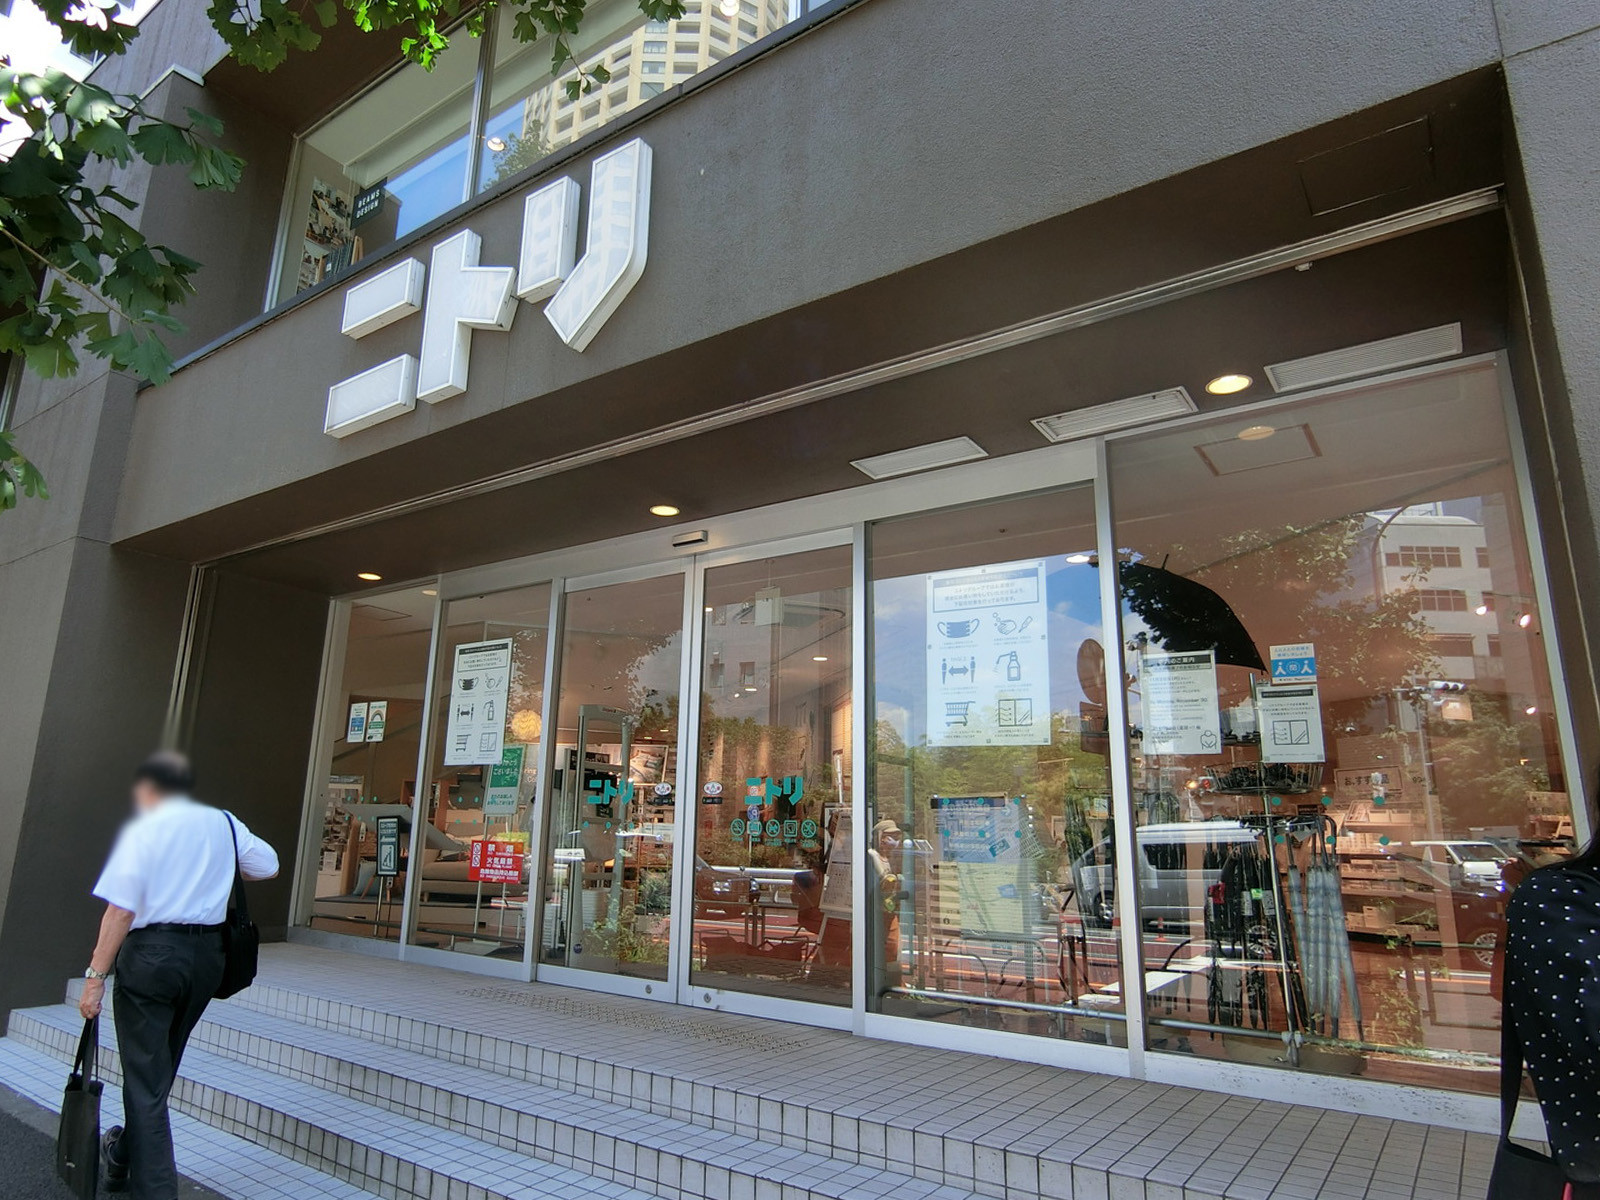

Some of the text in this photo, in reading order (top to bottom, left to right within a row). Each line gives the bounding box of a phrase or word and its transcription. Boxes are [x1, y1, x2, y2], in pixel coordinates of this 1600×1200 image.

[356, 199, 379, 219] DESIGN
[358, 188, 380, 208] BEAMS
[324, 137, 653, 439] ニトリ
[587, 779, 634, 805] ニトリ
[745, 776, 803, 806] ニトリ
